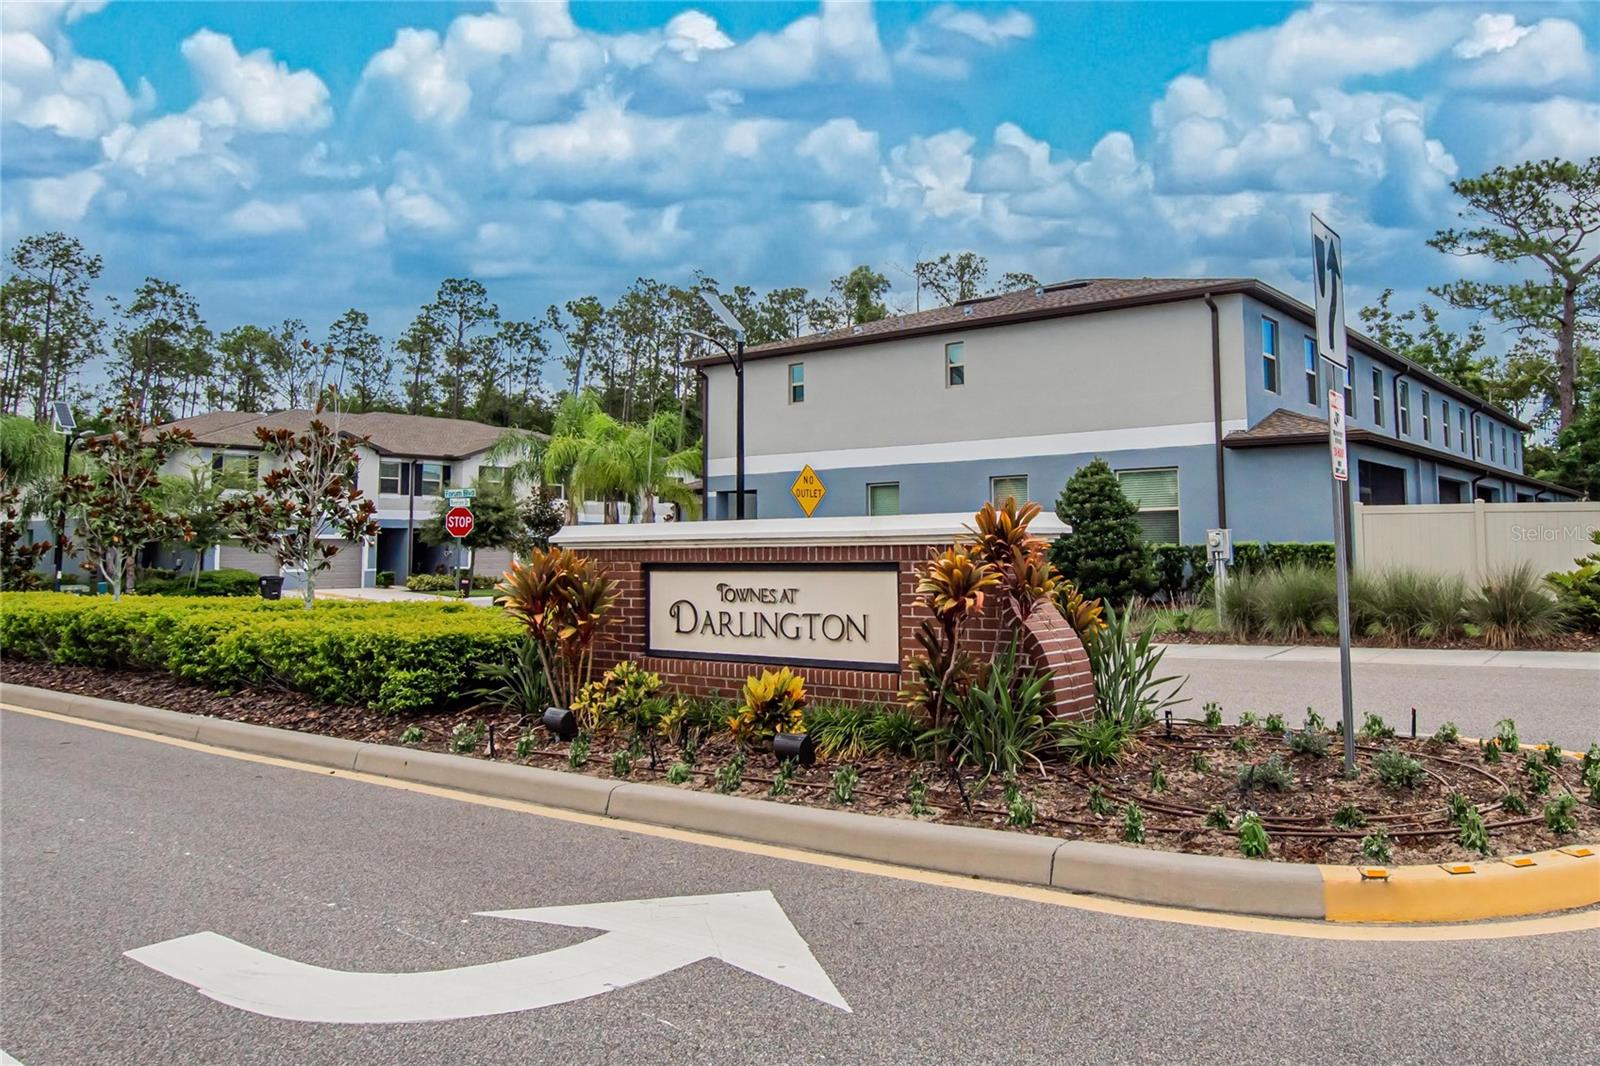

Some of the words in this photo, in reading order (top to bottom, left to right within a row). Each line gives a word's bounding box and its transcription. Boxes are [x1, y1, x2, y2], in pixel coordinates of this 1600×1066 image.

[803, 476, 814, 484] NO
[796, 488, 822, 498] OUTLET
[448, 515, 472, 528] STOP
[716, 582, 777, 604] TOWNES
[779, 588, 800, 604] AT
[669, 599, 869, 642] DARLINGTON
